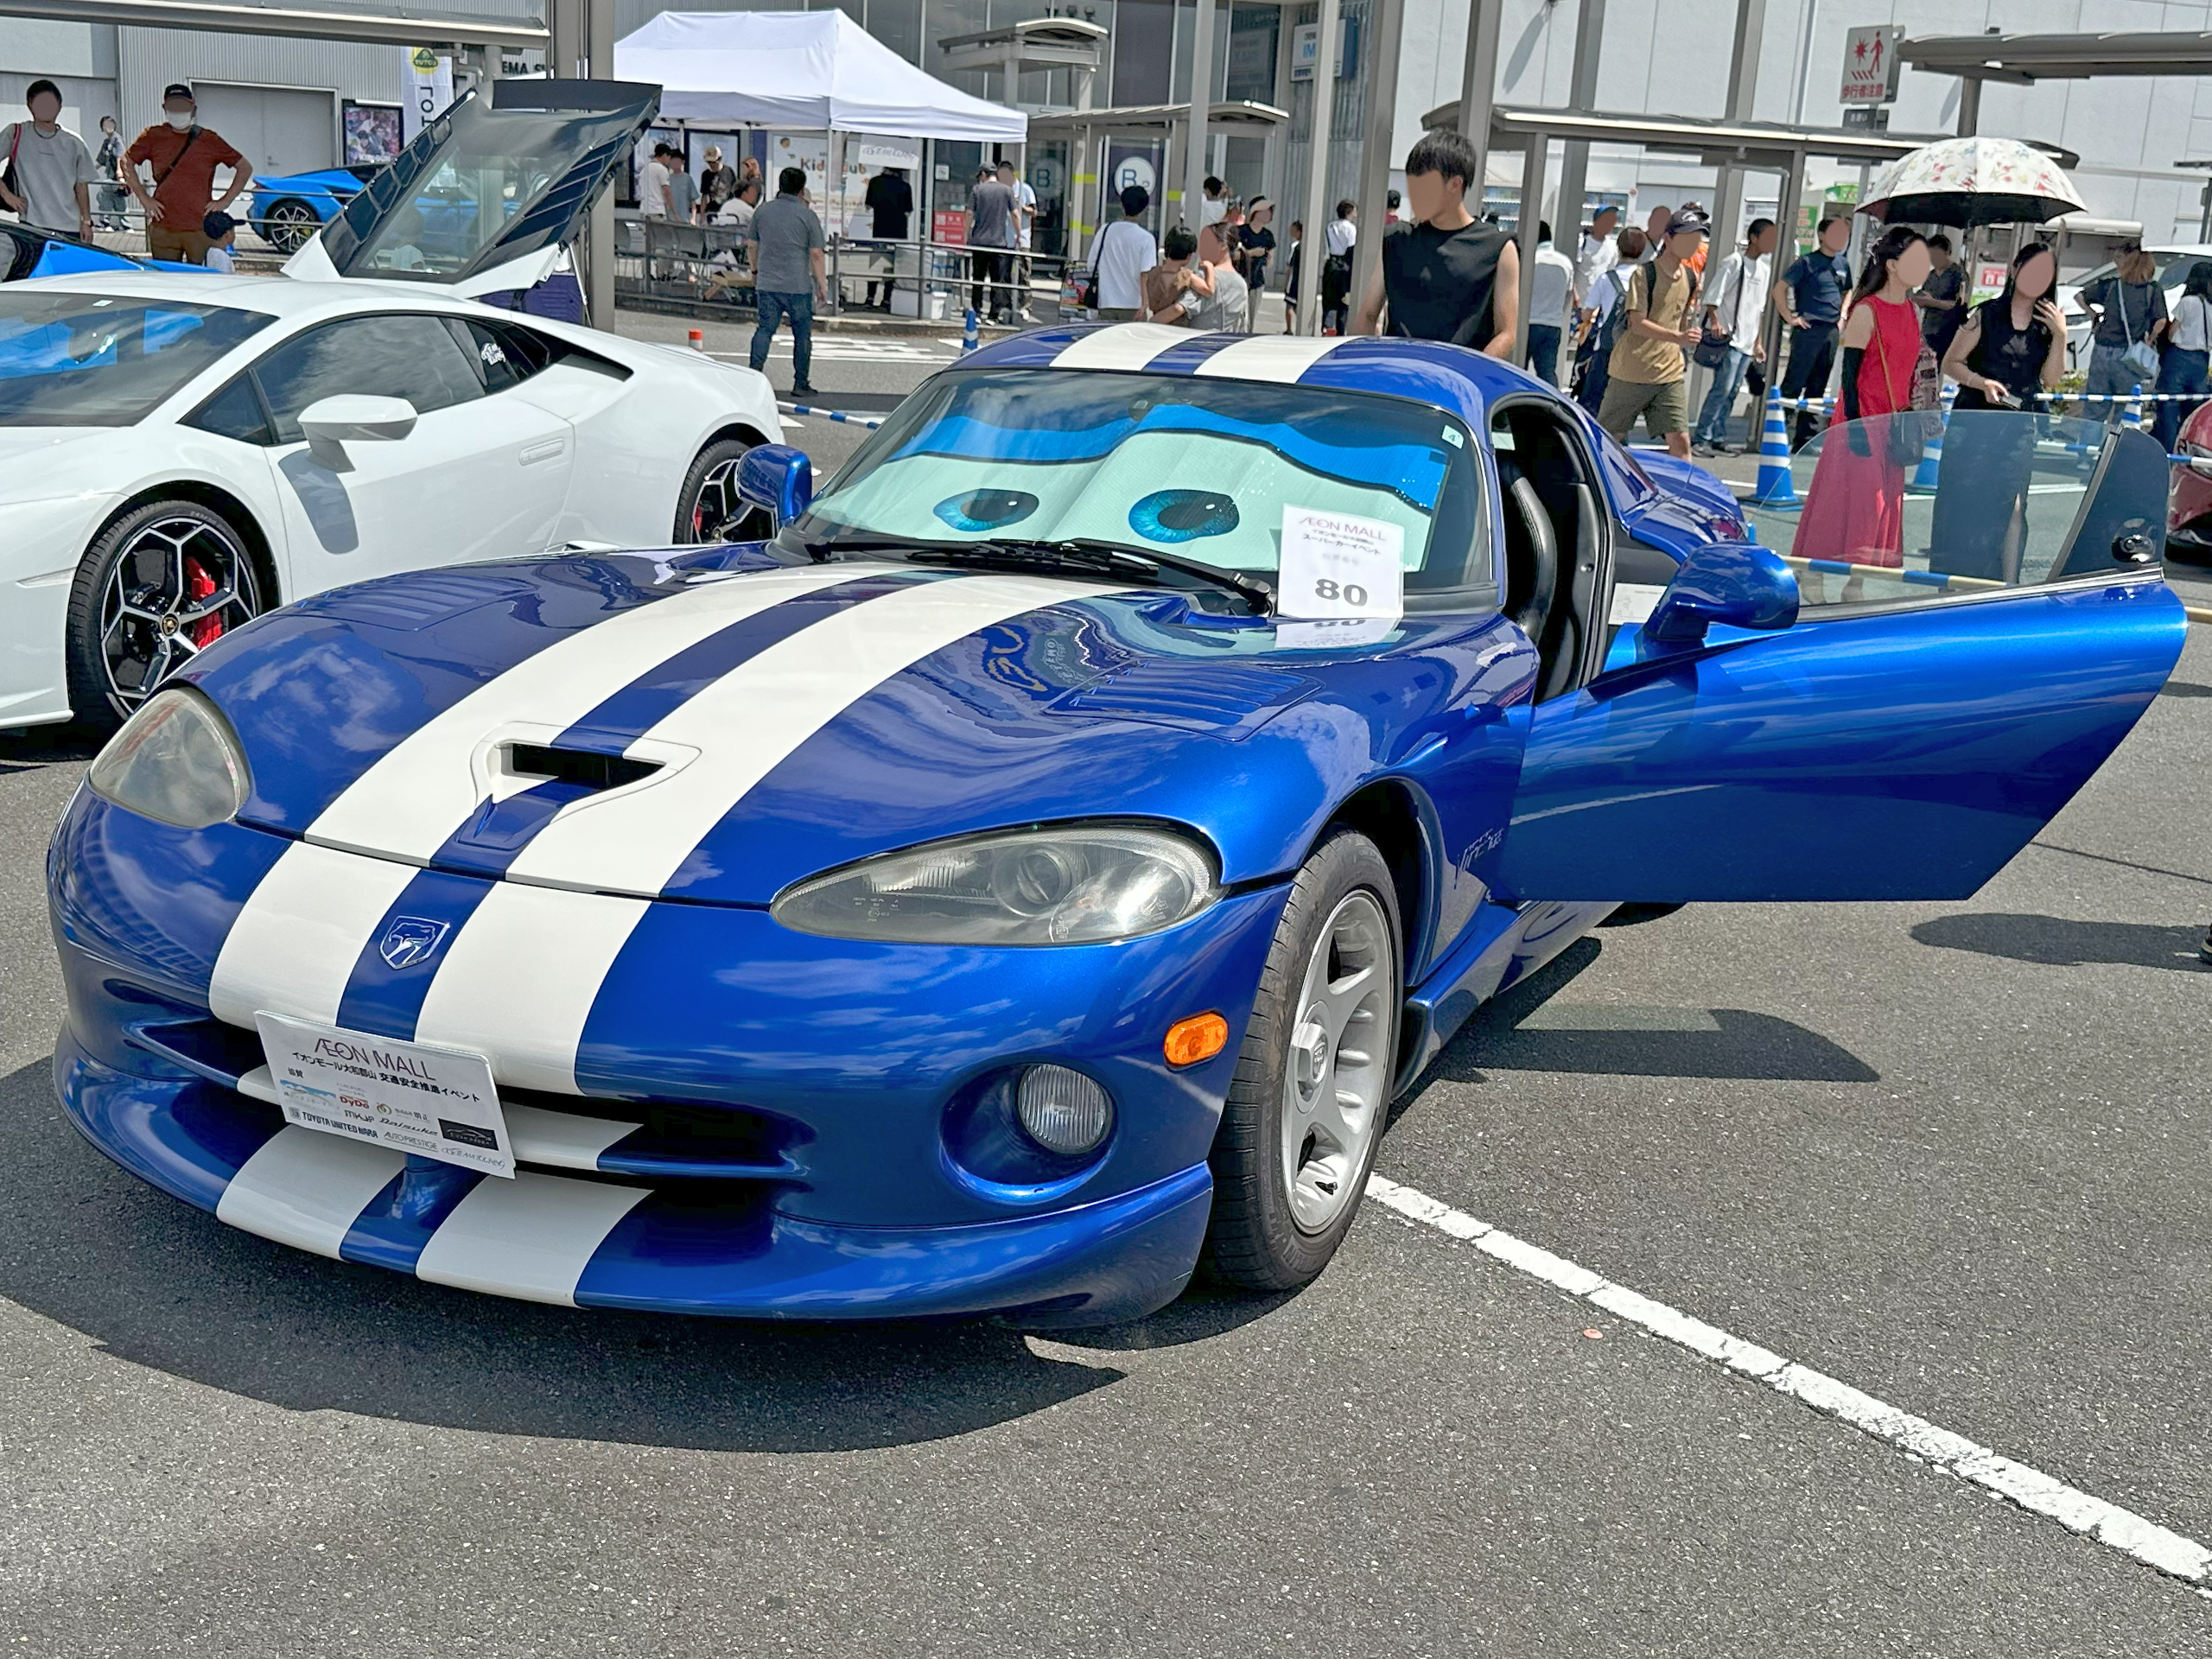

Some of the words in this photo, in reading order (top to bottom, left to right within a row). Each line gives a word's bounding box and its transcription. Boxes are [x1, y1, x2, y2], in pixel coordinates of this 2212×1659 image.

[1303, 533, 1381, 556] スーパーカーイベント
[1344, 524, 1387, 542] MALL
[1314, 578, 1368, 607] 80
[372, 1049, 436, 1081] MALL
[339, 1095, 370, 1109] DyDo
[302, 1111, 329, 1127] TOYOTA
[329, 1119, 358, 1134] UNITED
